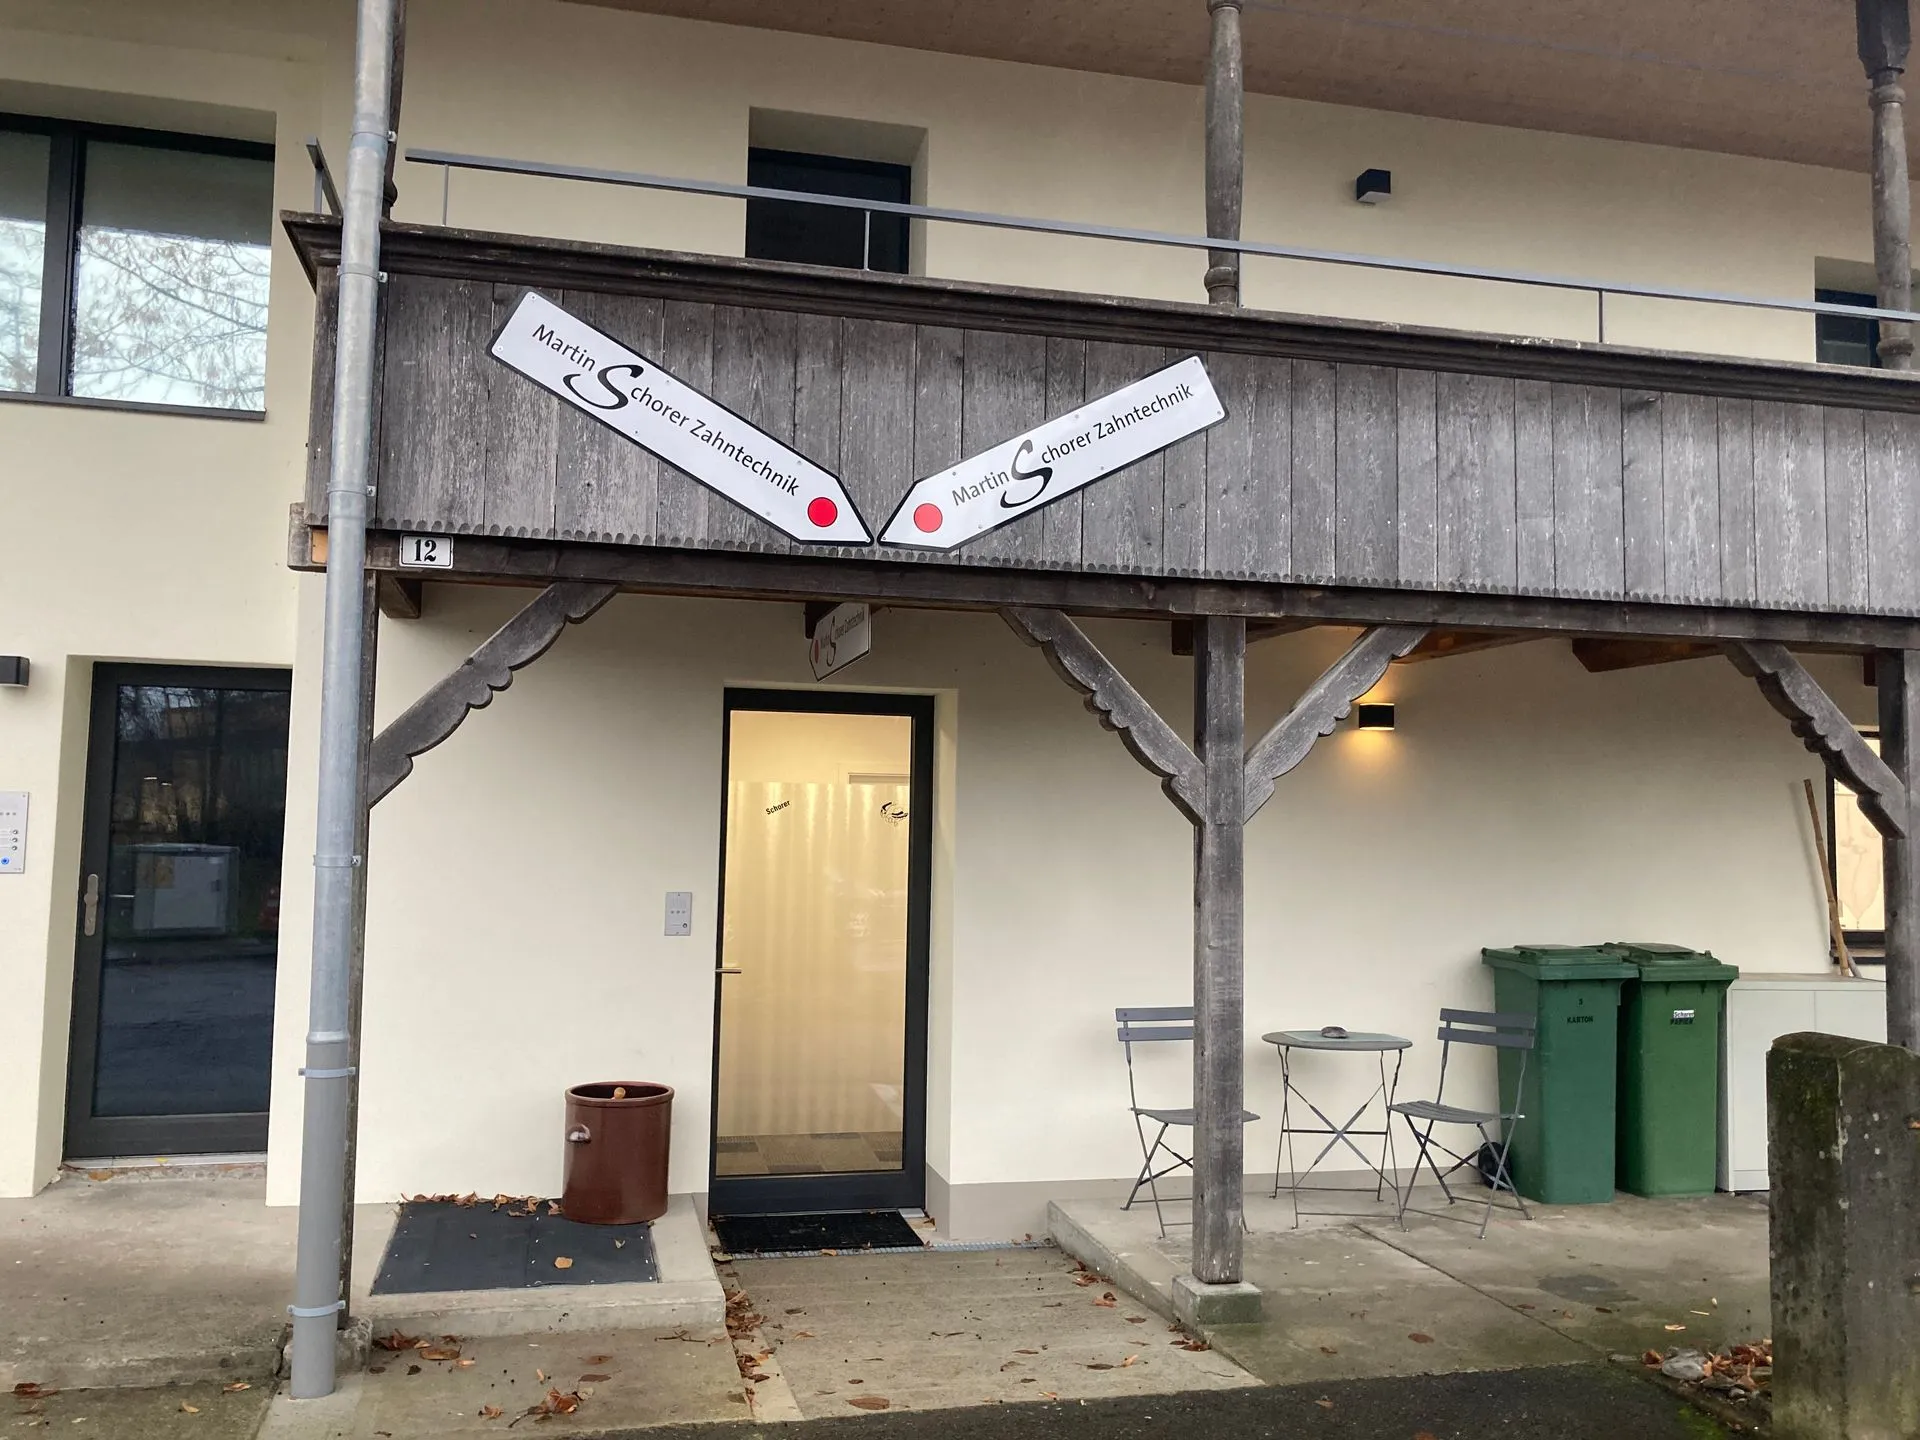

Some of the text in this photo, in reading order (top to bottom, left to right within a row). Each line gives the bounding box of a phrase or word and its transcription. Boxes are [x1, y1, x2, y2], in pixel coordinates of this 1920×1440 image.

[532, 324, 800, 496] Martin Schorer Zahntechnik
[952, 383, 1194, 508] Martin Schorer Zahntechnik
[414, 539, 437, 562] 12
[765, 800, 791, 815] Schorer
[1567, 1016, 1594, 1024] KARTON
